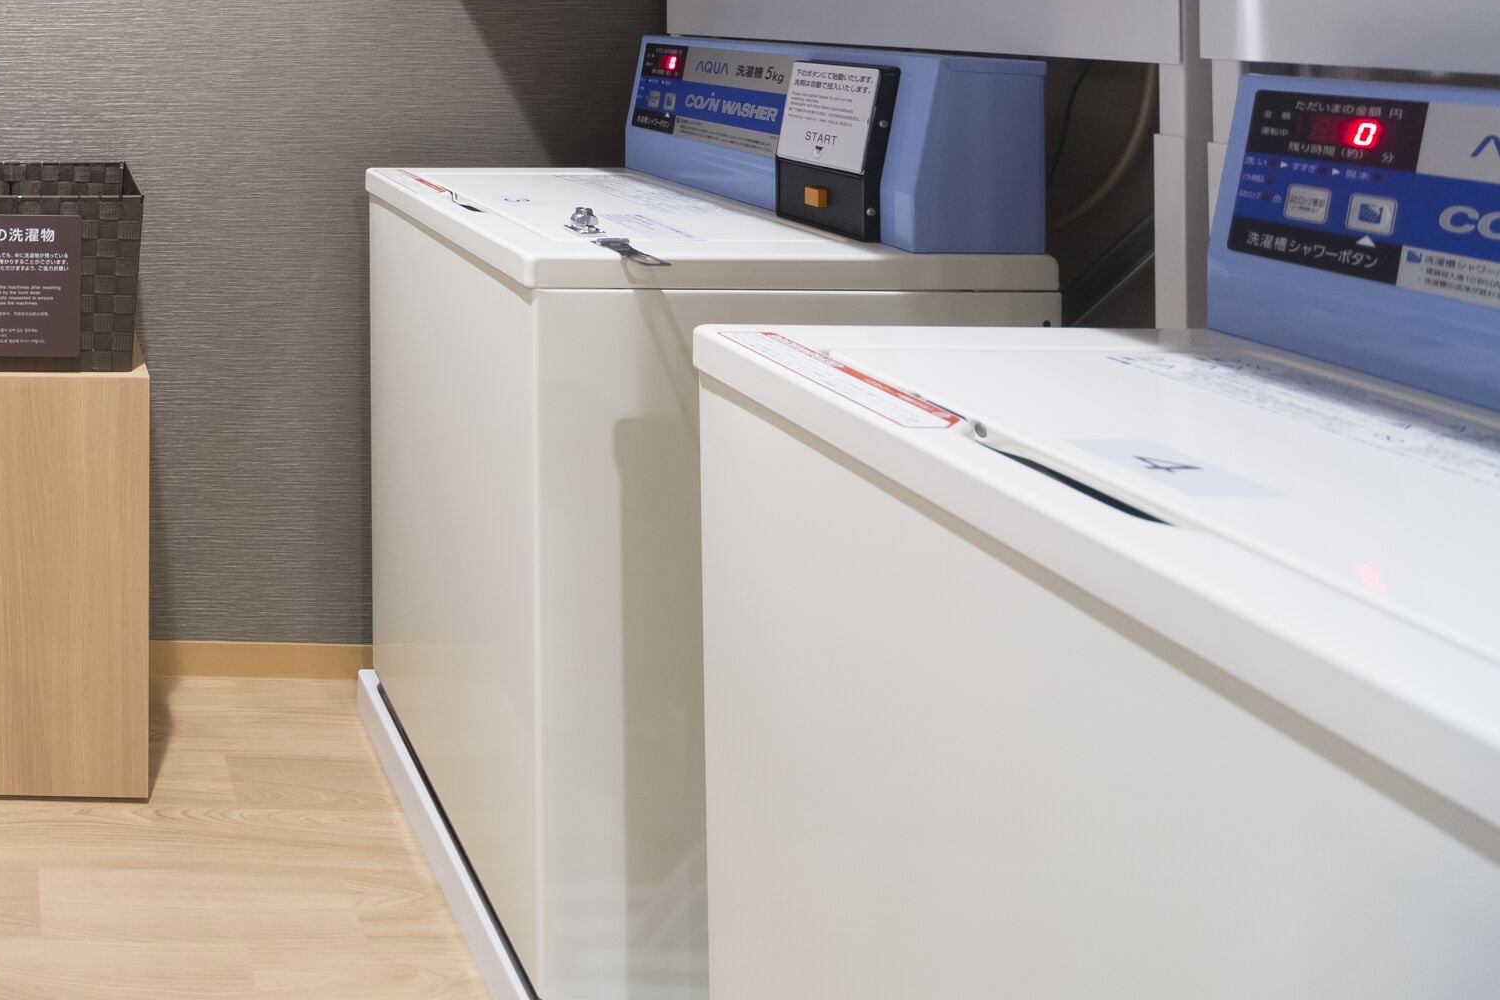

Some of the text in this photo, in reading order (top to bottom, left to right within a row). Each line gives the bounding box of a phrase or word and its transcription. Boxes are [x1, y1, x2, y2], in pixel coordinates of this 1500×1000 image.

[695, 60, 784, 84] AQUA 洗濯機 5kg
[685, 92, 720, 112] COIN
[722, 100, 779, 122] WASHER
[1295, 100, 1403, 120] ただいまの金額 円
[804, 130, 838, 145] START
[1353, 122, 1377, 146] 0
[1292, 162, 1316, 173] すすぎ
[1381, 152, 1394, 164] 分
[1246, 230, 1379, 268] 洗濯槽シャワーボタン
